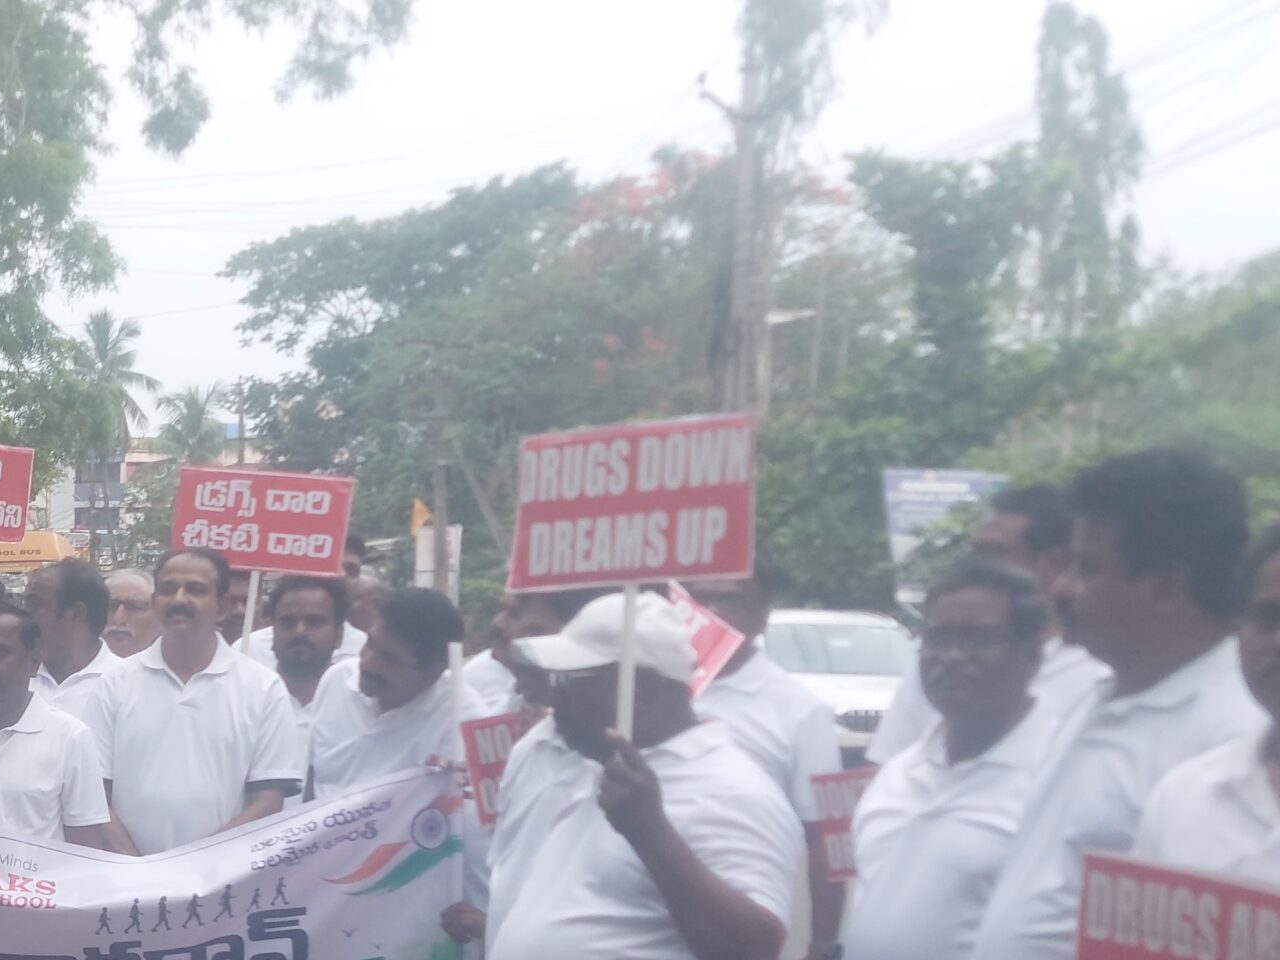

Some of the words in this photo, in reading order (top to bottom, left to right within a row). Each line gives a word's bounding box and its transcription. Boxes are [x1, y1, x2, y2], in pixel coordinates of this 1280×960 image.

[519, 438, 631, 504] DRUGS
[637, 426, 753, 492] DOWN
[194, 479, 257, 518] డ్రగ్స్
[265, 489, 332, 515] దారి
[182, 519, 260, 552] చీకటి
[267, 532, 333, 559] దారి
[528, 510, 670, 577] DREAMS
[675, 506, 728, 566] UP
